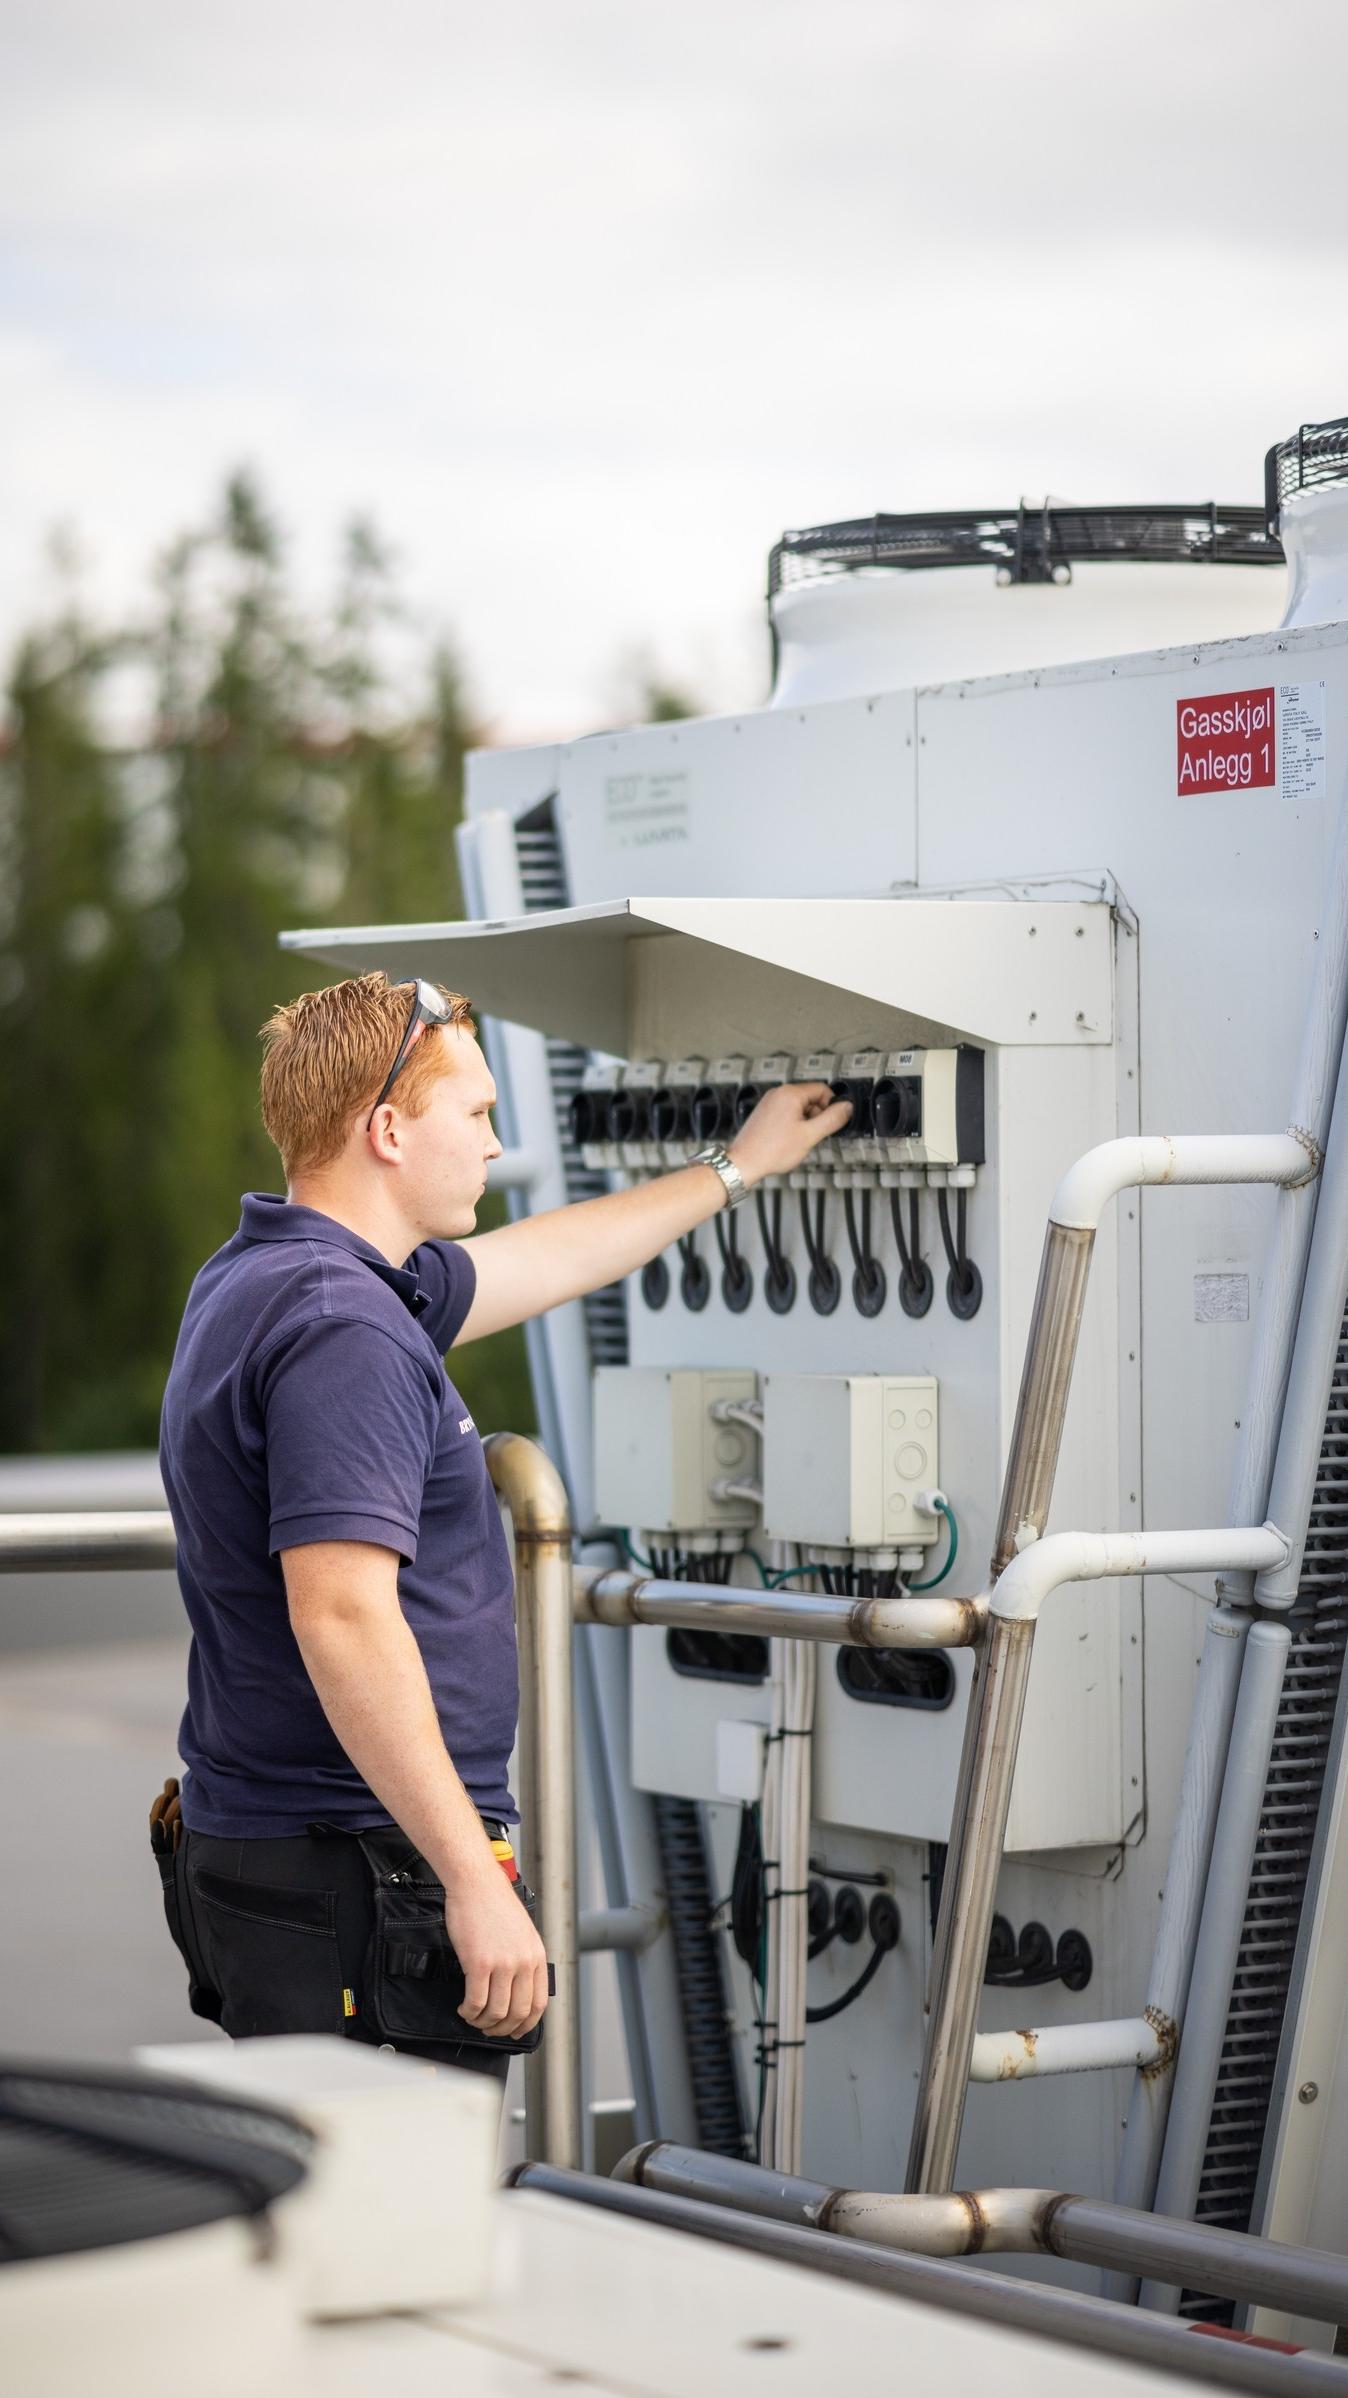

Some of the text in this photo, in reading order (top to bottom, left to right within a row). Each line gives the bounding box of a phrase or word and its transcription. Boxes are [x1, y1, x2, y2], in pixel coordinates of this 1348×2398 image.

[1181, 697, 1270, 738] Gasskjøl
[1180, 750, 1251, 785] Anlegg
[1260, 743, 1269, 773] 1
